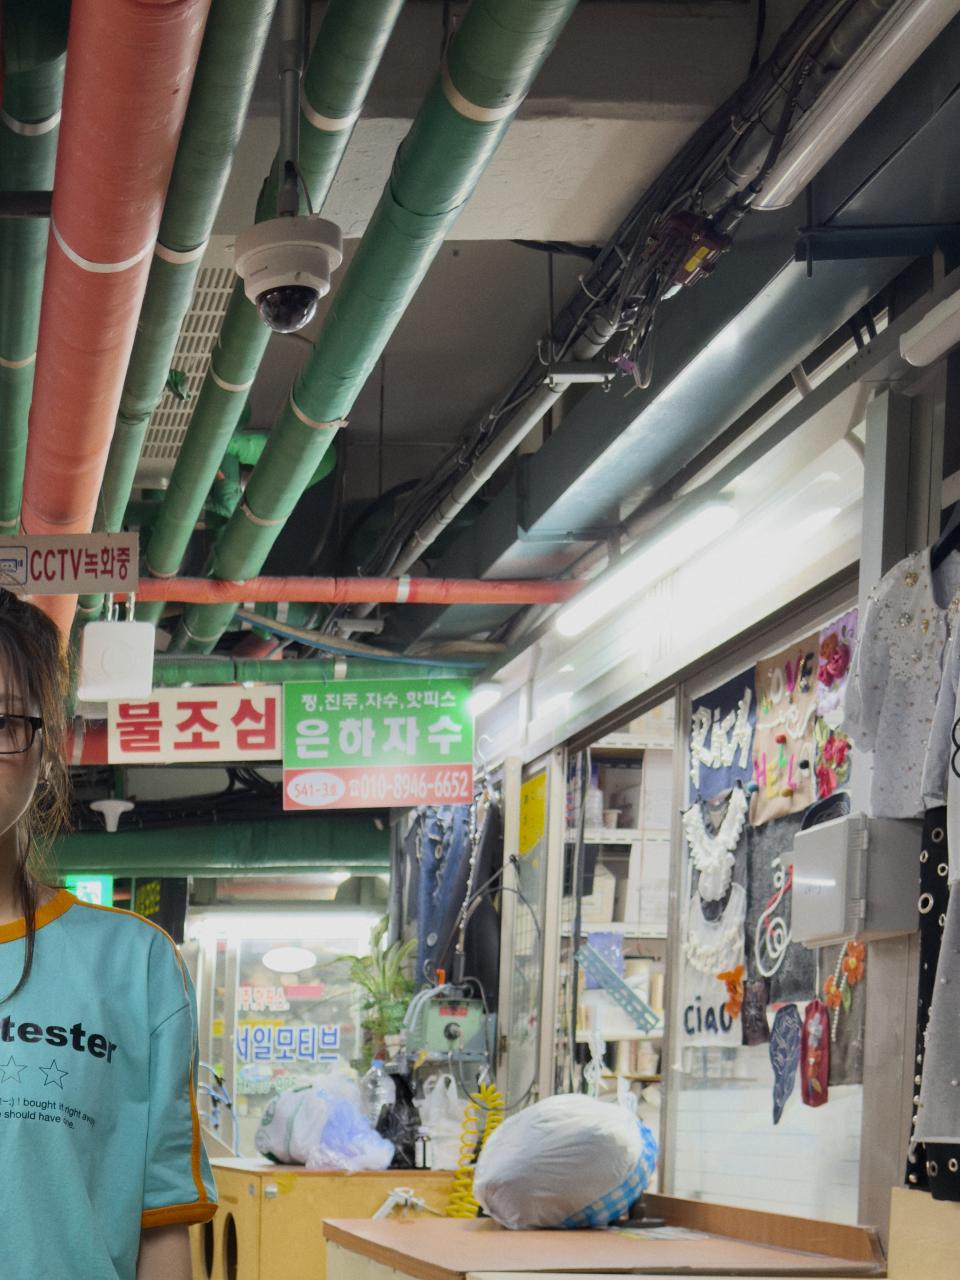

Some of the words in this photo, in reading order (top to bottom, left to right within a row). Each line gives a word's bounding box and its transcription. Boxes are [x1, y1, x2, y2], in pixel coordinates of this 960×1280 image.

[116, 697, 277, 754] 불조심
[296, 715, 463, 759] 은하자수
[4, 1109, 36, 1120] should
[38, 1112, 61, 1123] have
[23, 1097, 56, 1110] bought
[64, 1106, 81, 1119] right
